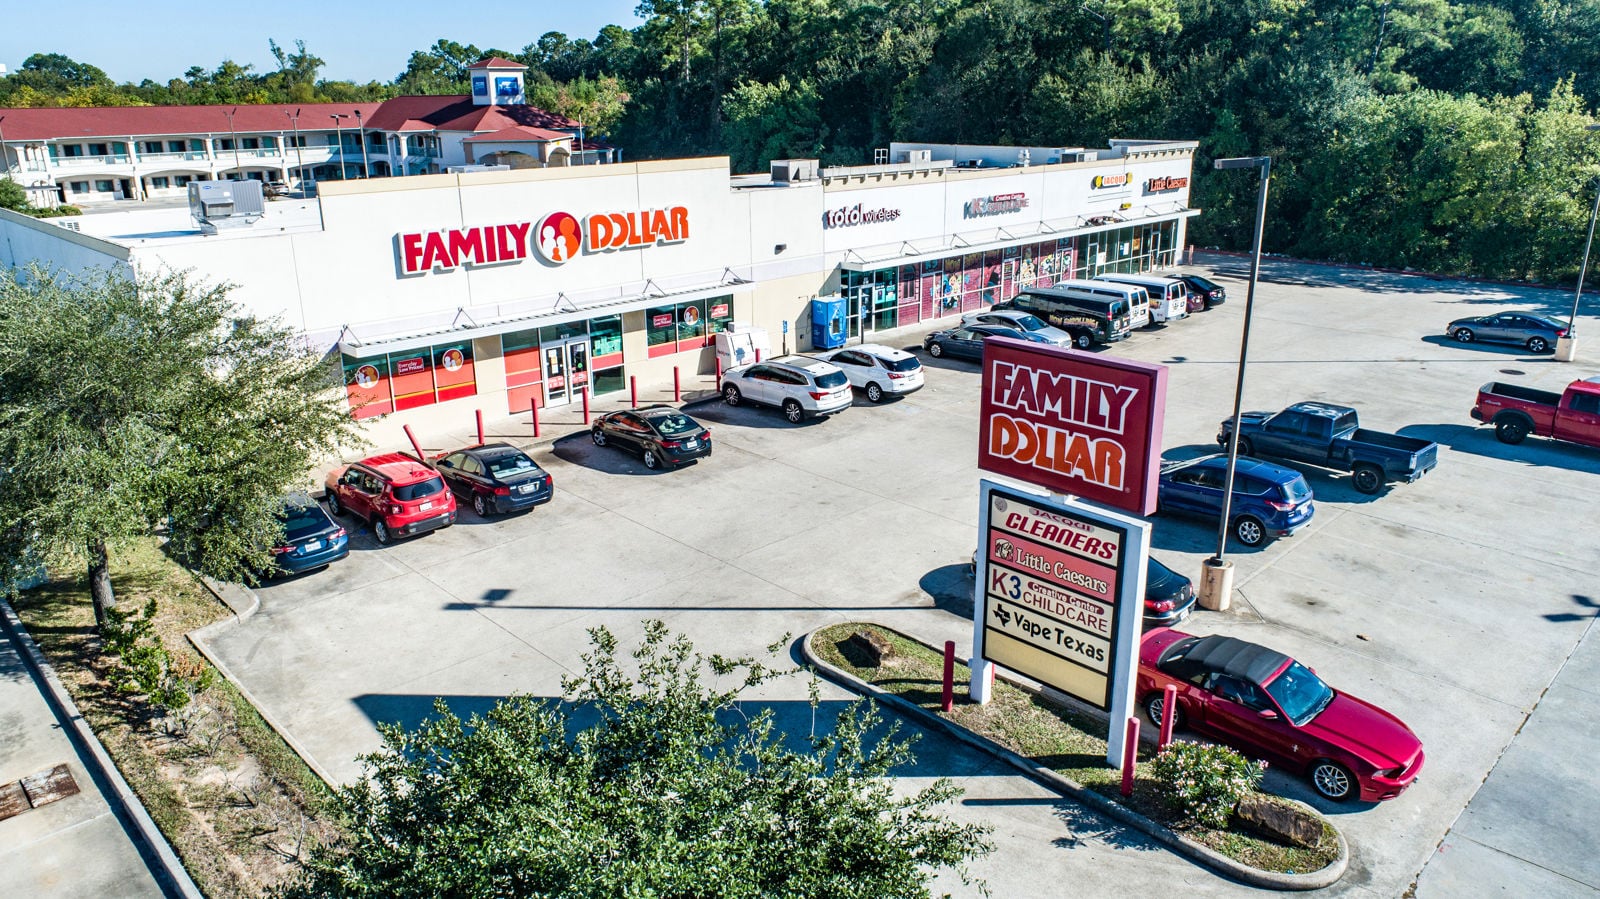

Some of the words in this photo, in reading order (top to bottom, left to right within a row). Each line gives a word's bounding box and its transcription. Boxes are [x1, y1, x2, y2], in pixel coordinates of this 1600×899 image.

[1150, 177, 1166, 191] Little
[1166, 175, 1188, 189] Caesars
[403, 221, 531, 272] FAMILY
[588, 205, 690, 251] DOLLAR
[826, 203, 864, 227] total
[864, 207, 901, 223] wireless
[991, 360, 1139, 435] FAMILY
[989, 413, 1126, 491] DOLLAR
[1005, 512, 1117, 560] CLEANERS
[992, 568, 1022, 600] K3
[1016, 546, 1051, 574] Little
[1053, 561, 1108, 594] Caesars
[1023, 591, 1108, 633] CHILDCARE
[1031, 583, 1067, 602] Creative
[1069, 595, 1100, 614] Center
[1014, 611, 1052, 639] Vape
[1054, 627, 1105, 662] Texas
